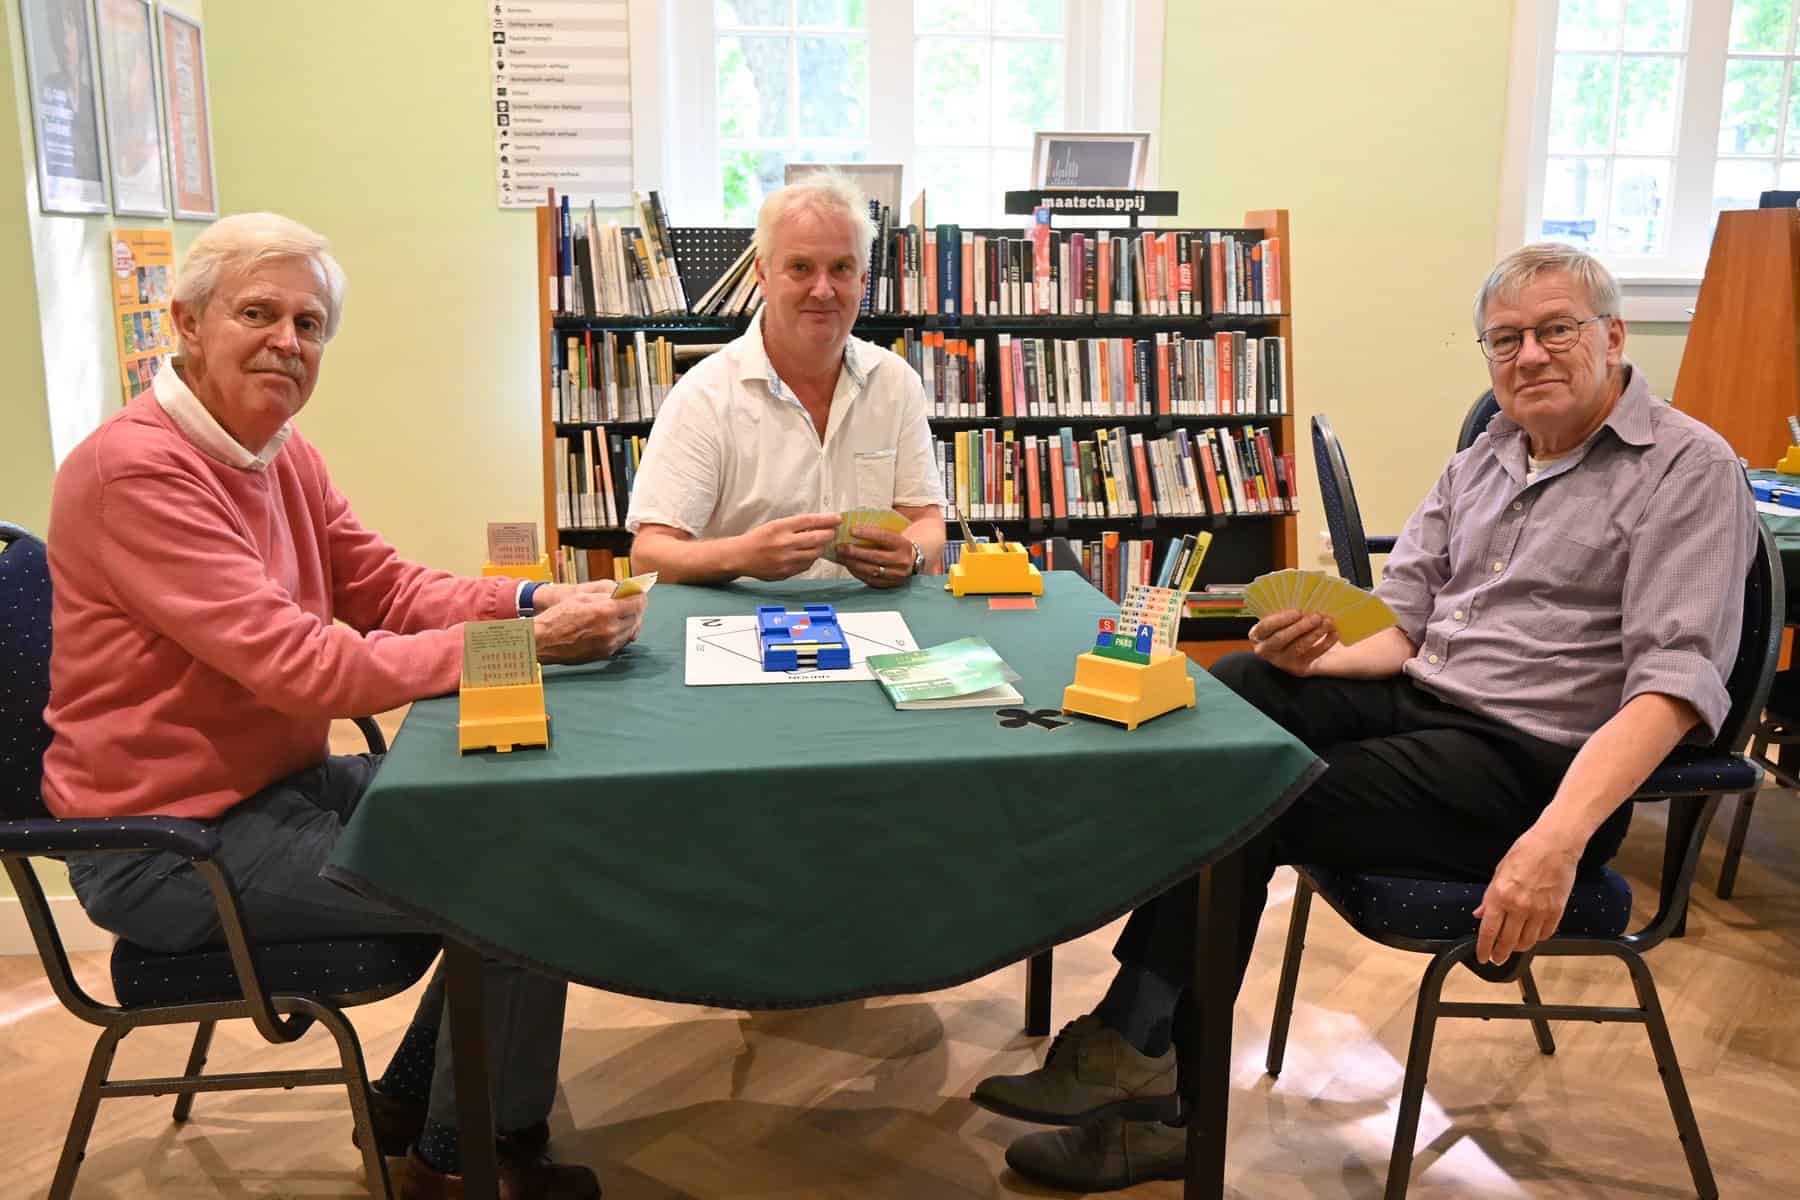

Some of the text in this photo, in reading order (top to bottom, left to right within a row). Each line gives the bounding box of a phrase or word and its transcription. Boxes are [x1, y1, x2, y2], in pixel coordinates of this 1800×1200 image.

[1041, 195, 1145, 211] maatschappij
[1103, 620, 1111, 630] S
[1141, 627, 1149, 637] A
[1115, 637, 1133, 648] PASS
